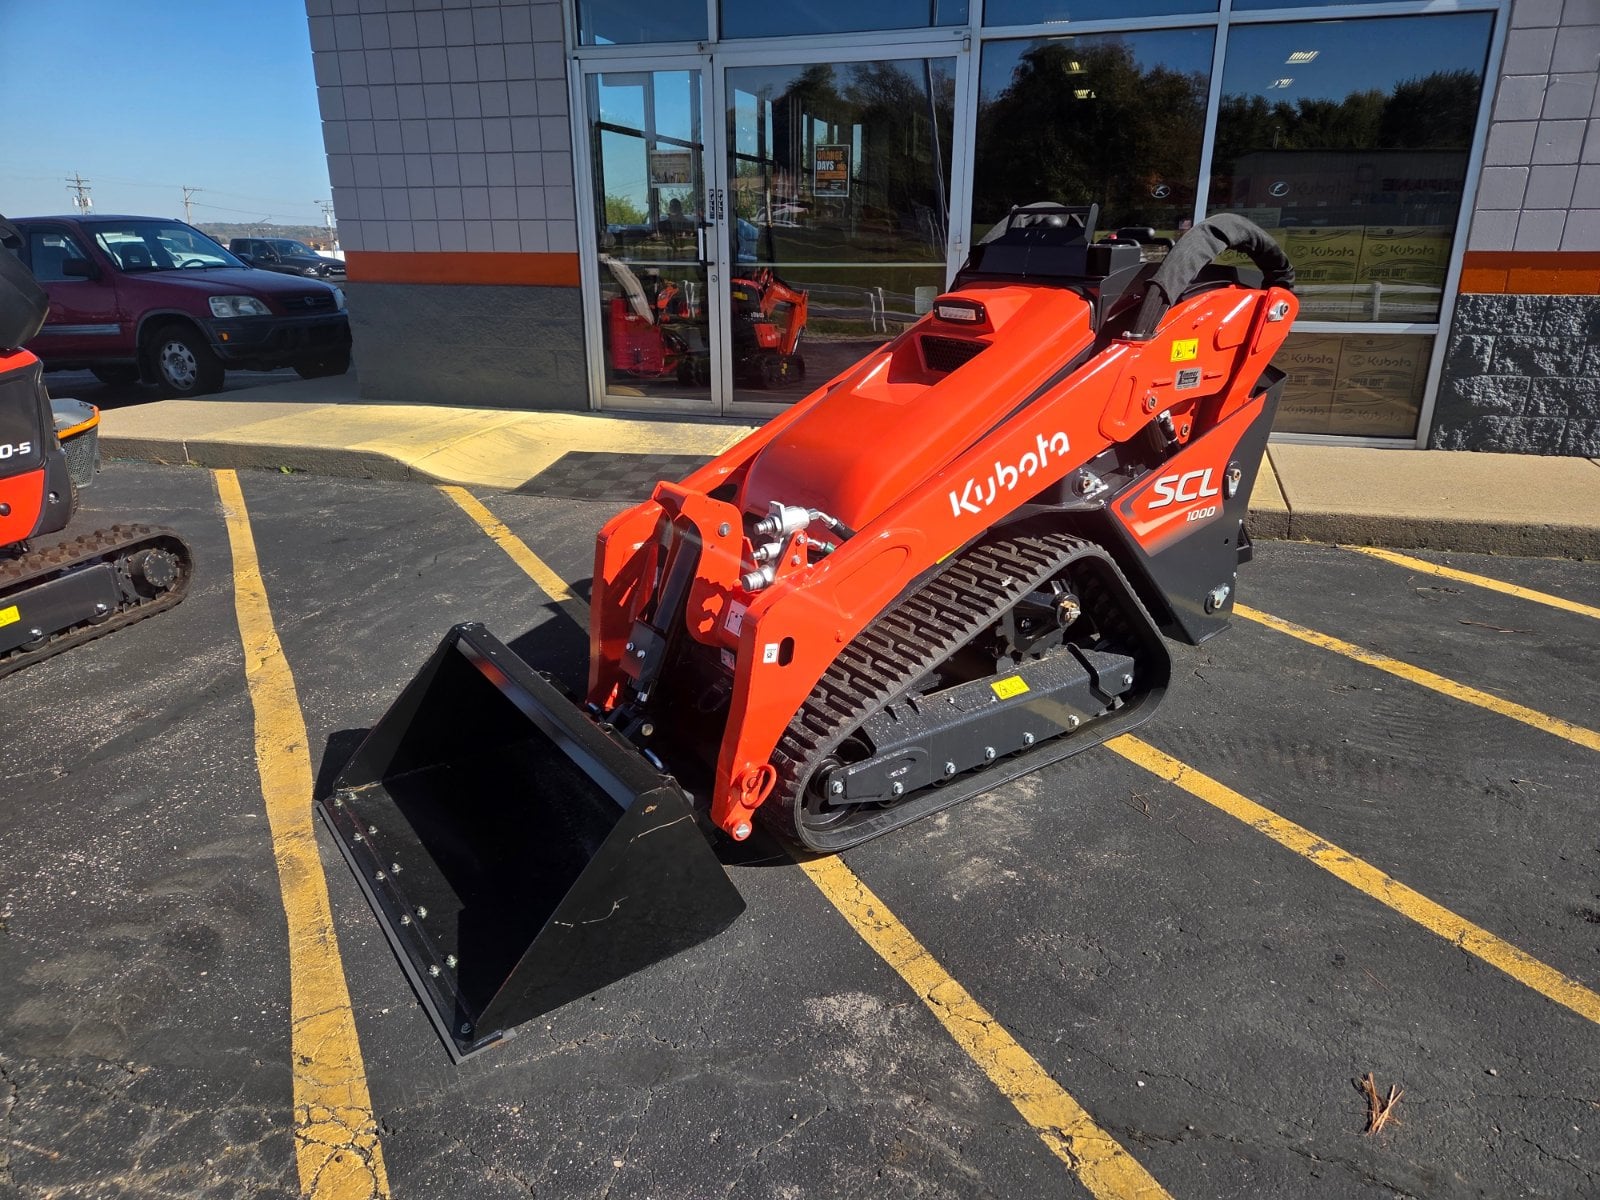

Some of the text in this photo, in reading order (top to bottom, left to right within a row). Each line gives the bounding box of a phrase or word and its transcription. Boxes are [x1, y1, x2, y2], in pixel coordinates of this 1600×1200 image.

[816, 160, 835, 171] DAYS
[1310, 246, 1355, 258] Kubota
[1389, 243, 1435, 256] Kubota
[1290, 353, 1335, 365] Kubota
[1367, 356, 1412, 368] Kubota
[1284, 405, 1325, 416] Kubota
[948, 430, 1071, 518] Kubota
[1148, 467, 1219, 510] SCL
[1186, 506, 1216, 522] 1000
